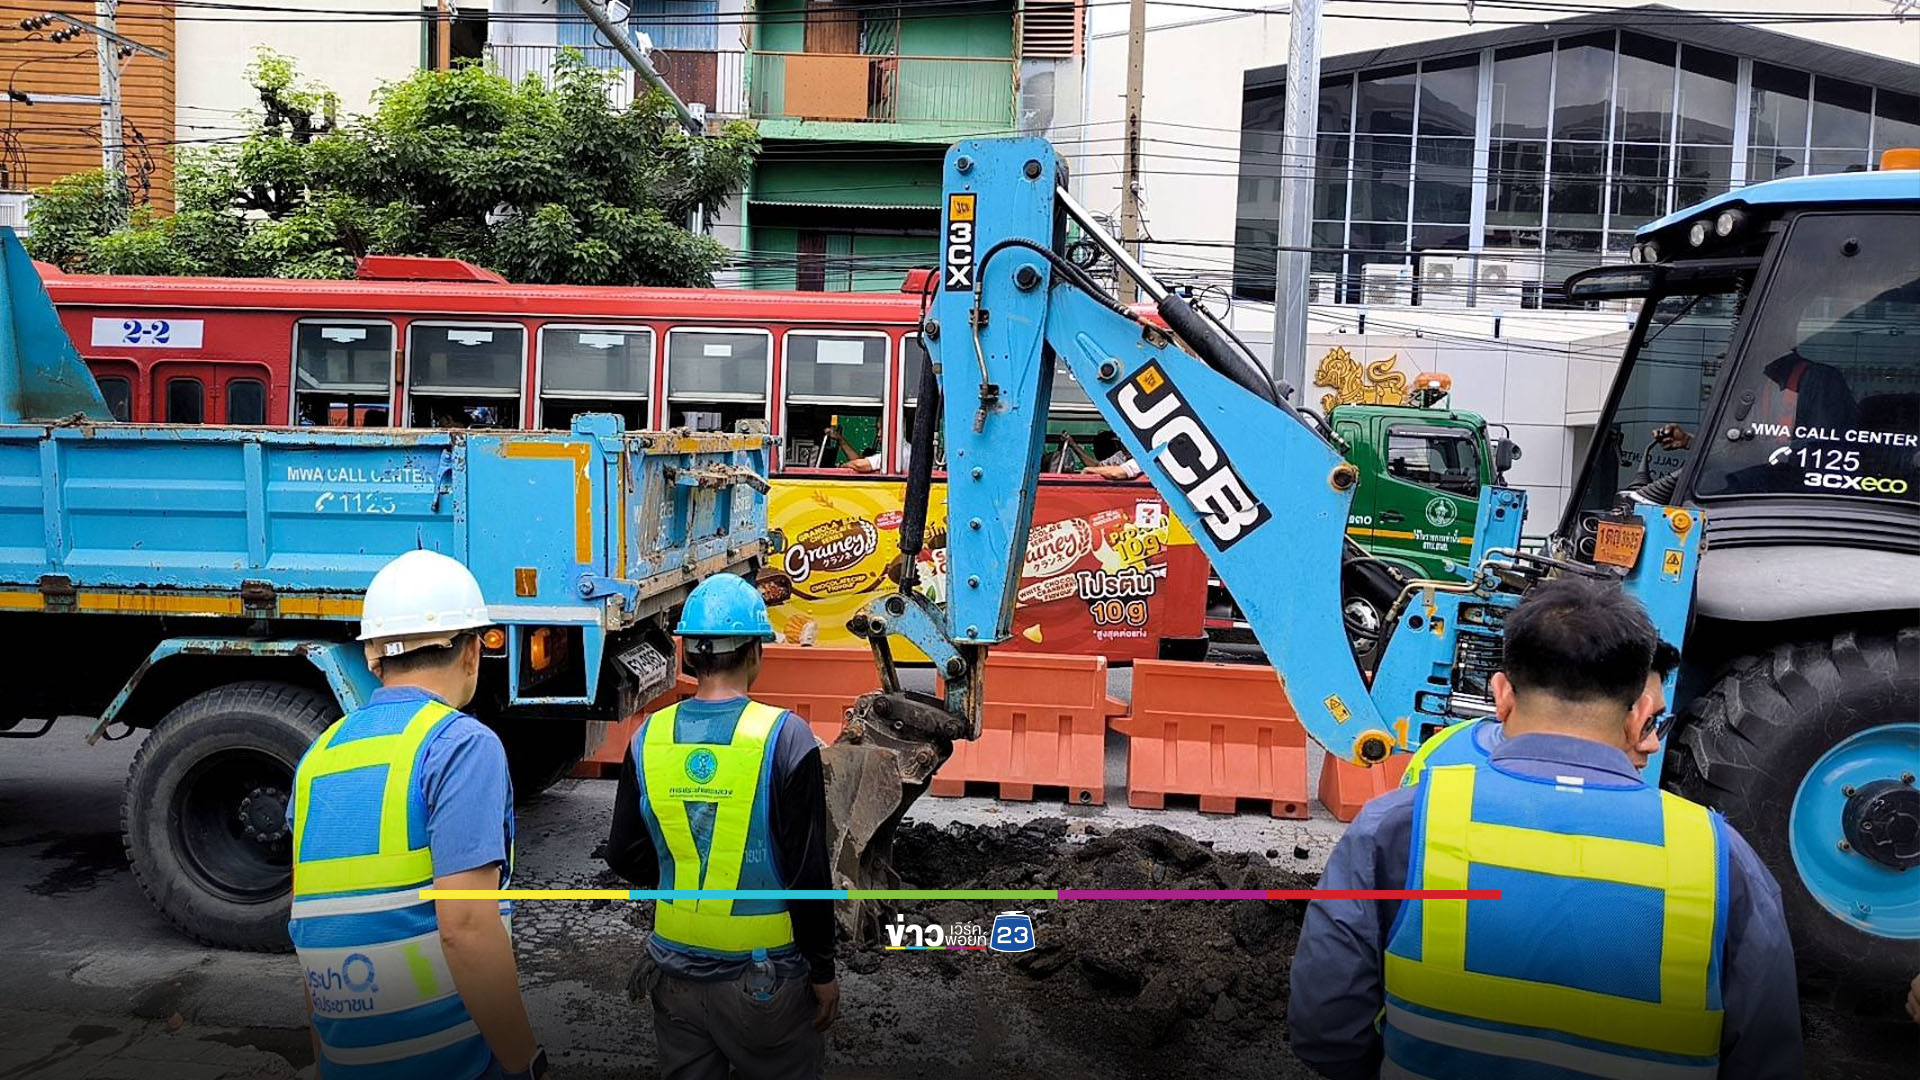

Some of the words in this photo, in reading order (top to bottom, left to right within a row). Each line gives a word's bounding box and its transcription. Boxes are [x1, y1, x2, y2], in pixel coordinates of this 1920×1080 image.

[946, 222, 972, 286] 3CX
[123, 320, 170, 344] 2-2
[1751, 422, 1791, 438] MWA
[1794, 426, 1841, 441] CALL
[1844, 429, 1918, 447] CENTER
[1117, 383, 1259, 541] JCB
[1796, 447, 1860, 472] 1125
[287, 466, 324, 481] MWA
[327, 467, 368, 482] CALL
[1803, 472, 1908, 494] 3CXeco
[1028, 523, 1062, 542] OCOLATE
[784, 534, 865, 582] Grainey
[1025, 533, 1077, 565] ainey
[1113, 534, 1162, 562] 10g
[1044, 575, 1076, 589] CHOCOL
[1078, 567, 1155, 599] โปรตีน
